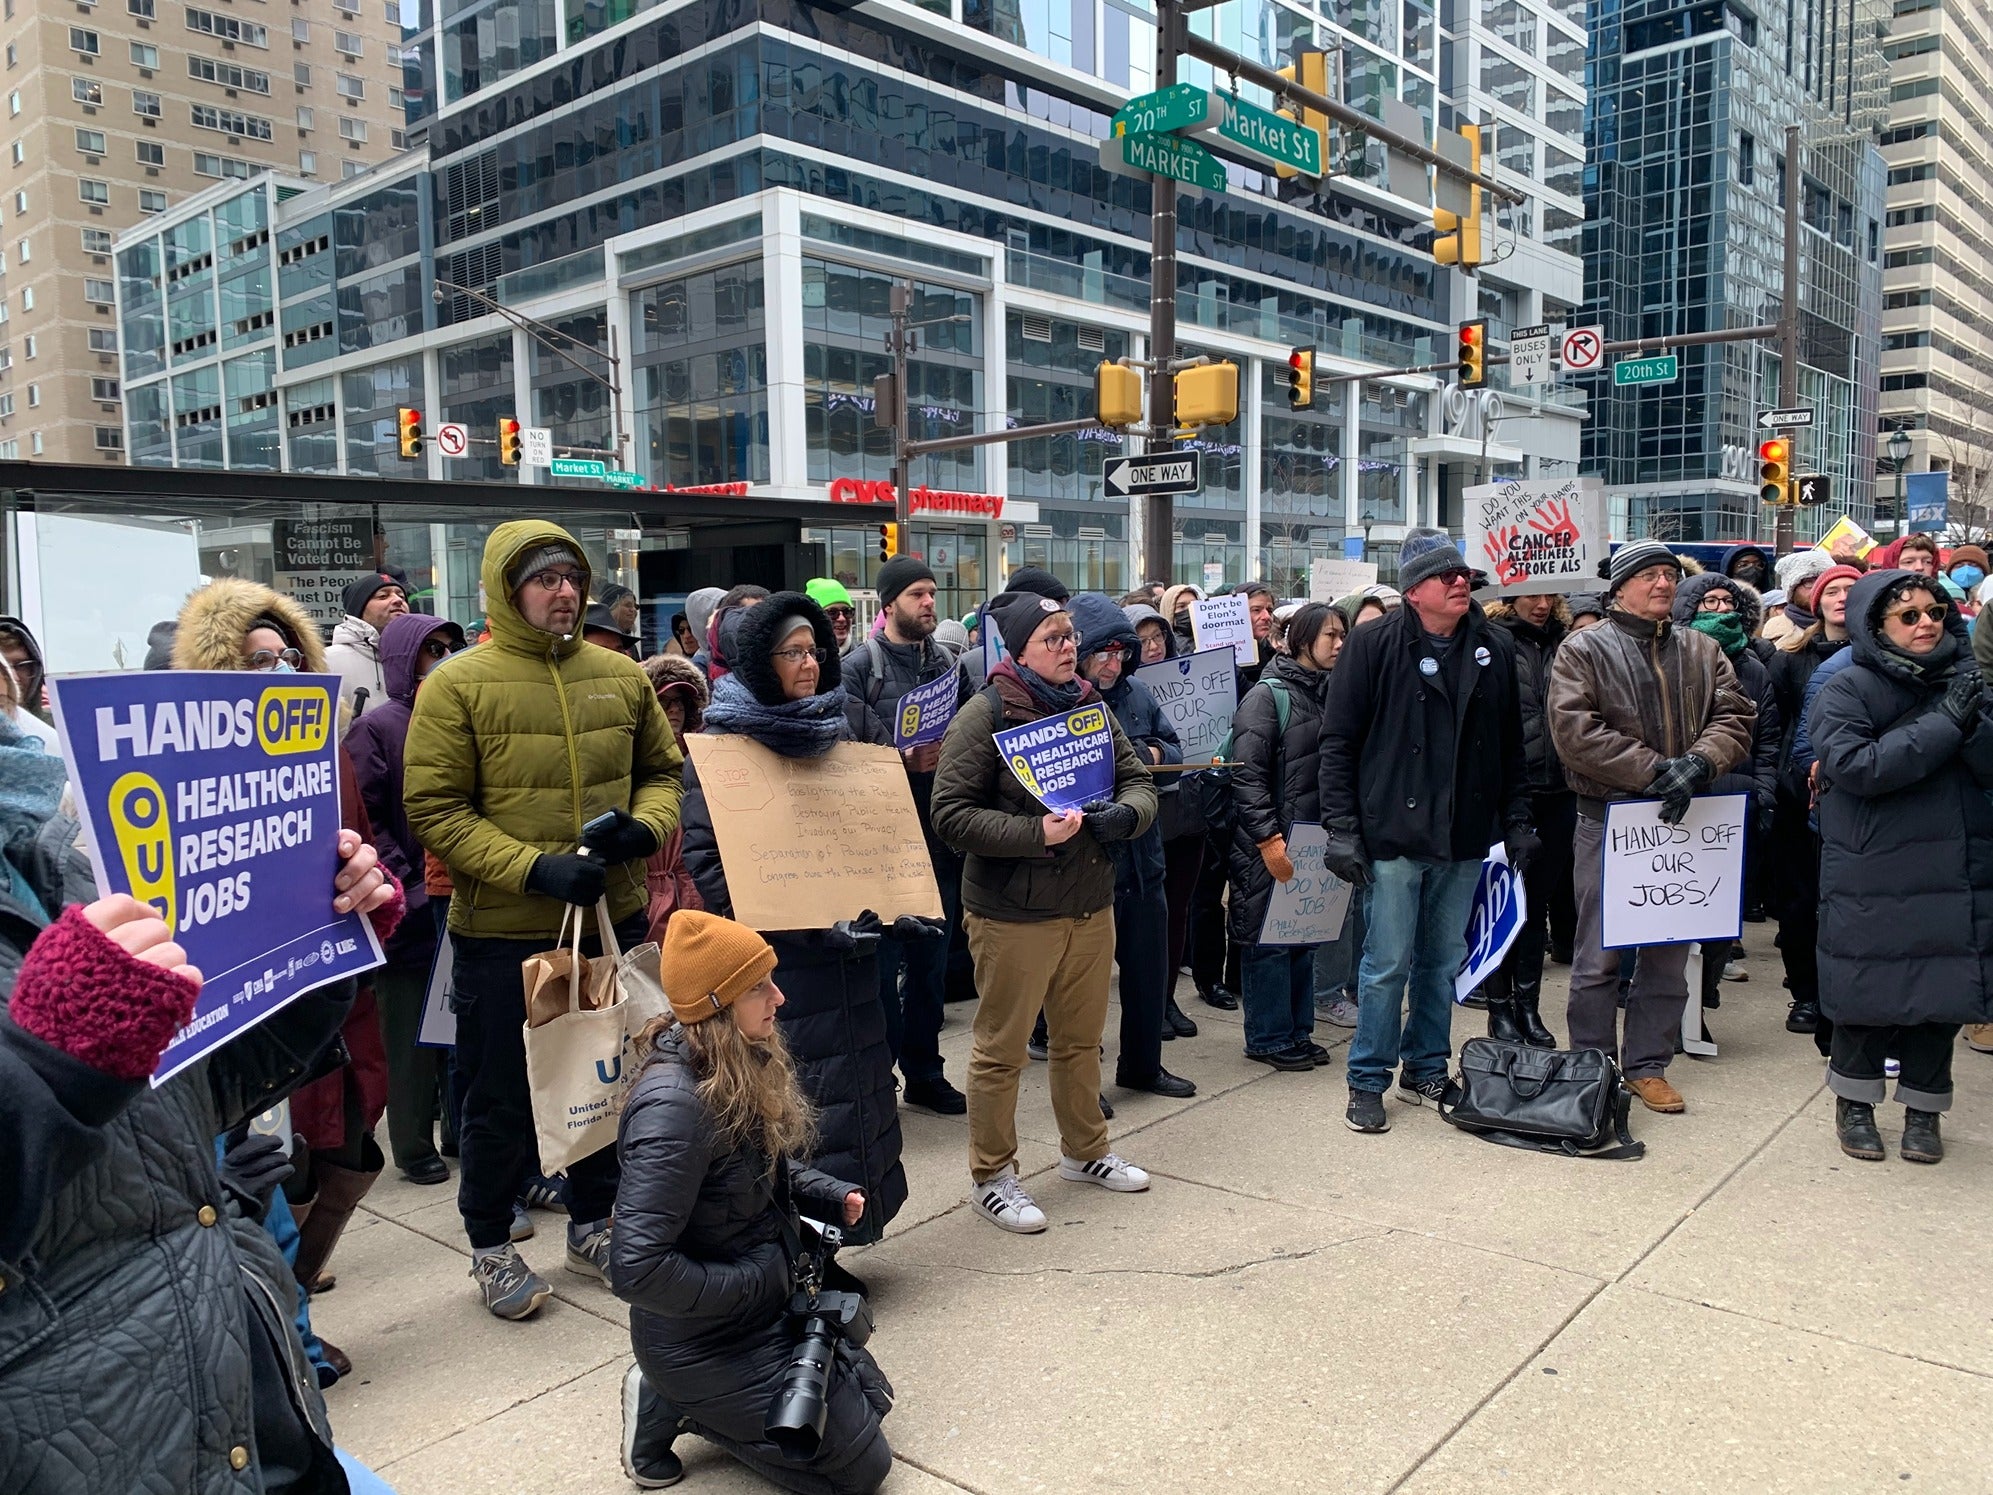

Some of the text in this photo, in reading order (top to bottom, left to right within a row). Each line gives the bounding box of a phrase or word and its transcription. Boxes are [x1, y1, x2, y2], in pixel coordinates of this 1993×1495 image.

[1133, 105, 1167, 132] 20TH
[1188, 99, 1202, 117] ST
[1225, 101, 1311, 164] Market St
[1130, 140, 1223, 190] MARKET ST
[1512, 326, 1548, 339] THIS LANE
[1513, 340, 1546, 354] BUSES
[1515, 353, 1543, 366] ONLY
[1624, 362, 1669, 380] 20th St
[1773, 412, 1809, 423] ONE WAY
[529, 431, 544, 441] NO
[555, 462, 600, 474] Market St
[1131, 464, 1188, 484] ONE WAY
[606, 474, 634, 485] MARKET
[830, 477, 1004, 519] CVS pharmacy
[1482, 481, 1521, 515] DO YOU
[1515, 480, 1576, 524] ON YOUR HANDS
[1479, 492, 1532, 530] WANT THIS
[294, 523, 353, 534] Fascism
[1001, 528, 1014, 536] CVS
[287, 537, 361, 549] Cannot Be
[1508, 532, 1571, 551] CANCER
[287, 553, 363, 566] Voted Out,
[1507, 547, 1575, 562] ALZHEIMERS
[1509, 560, 1581, 577] STROKE ALS
[287, 576, 358, 588] The Peop
[1200, 600, 1242, 612] Don't be
[1207, 610, 1237, 620] Elon's
[1202, 618, 1245, 630] doormat
[905, 669, 956, 704] HANDS
[1152, 670, 1231, 703] ANDS OFF
[1173, 699, 1212, 722] OUR
[95, 697, 325, 762] HANDS OFF!
[904, 707, 918, 735] OUR
[919, 710, 951, 732] JOBS
[1004, 711, 1102, 755] HANDS OFF!
[1030, 731, 1110, 766] HEALTHCARE
[1034, 748, 1104, 781] RESEARCH
[715, 767, 750, 783] STOP
[1041, 773, 1076, 794] JOBS
[176, 760, 332, 823] HEALTHCARE
[846, 804, 878, 816] Public
[861, 822, 897, 840] Privacy
[1612, 822, 1742, 852] HANDS OFF
[179, 808, 312, 878] RESEARCH
[1651, 851, 1696, 874] OUR
[759, 865, 799, 888] Congress
[1284, 875, 1346, 895] DO YOUR
[179, 871, 251, 933] JOBS
[1628, 876, 1722, 908] JOBS!
[186, 1003, 230, 1040] EDUCATION
[569, 1098, 608, 1115] United
[567, 1115, 602, 1130] Florida
